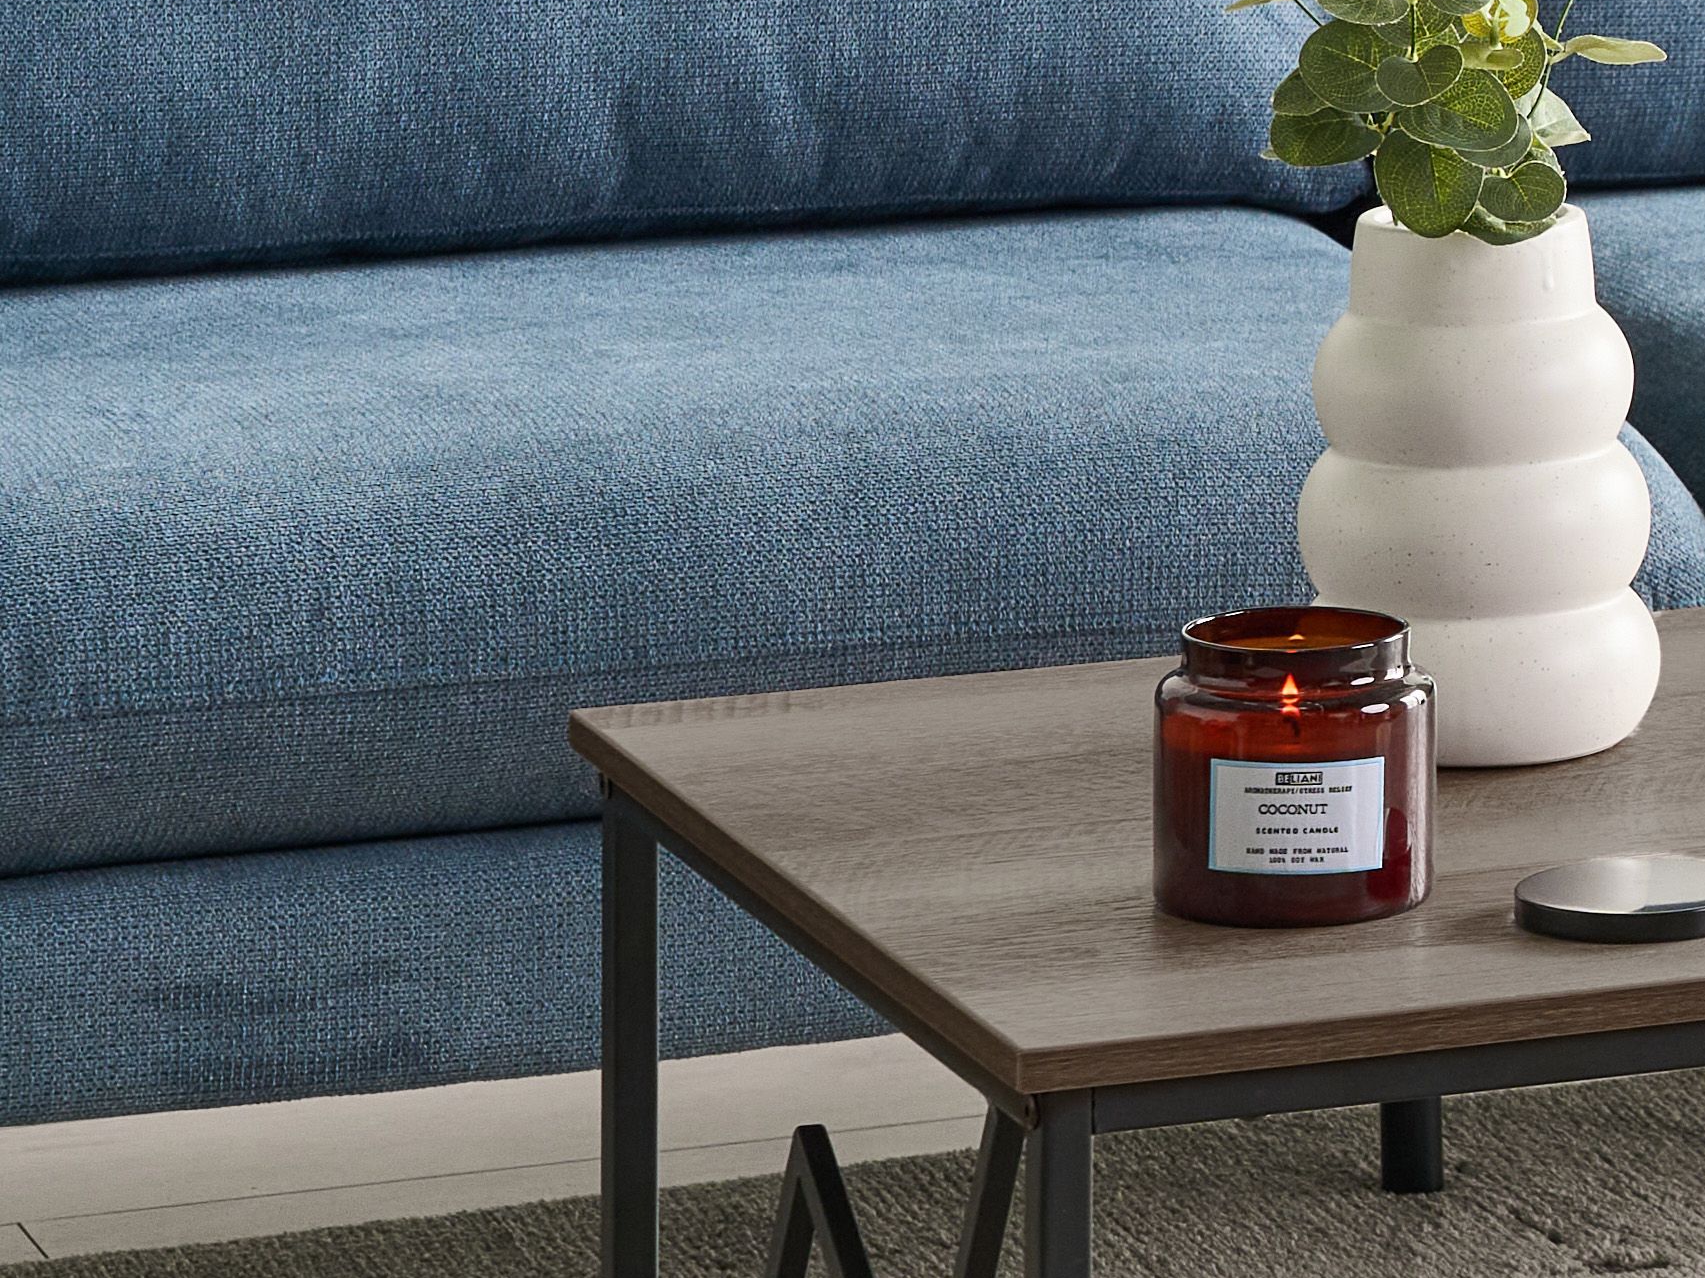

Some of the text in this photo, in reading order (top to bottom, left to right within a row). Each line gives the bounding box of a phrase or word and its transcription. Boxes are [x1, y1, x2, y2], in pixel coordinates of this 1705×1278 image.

[1276, 772, 1322, 785] BELIANI
[1258, 804, 1328, 815] COCONUT
[1256, 826, 1339, 835] SCENTED CANDLE
[1317, 846, 1348, 854] NATURAL
